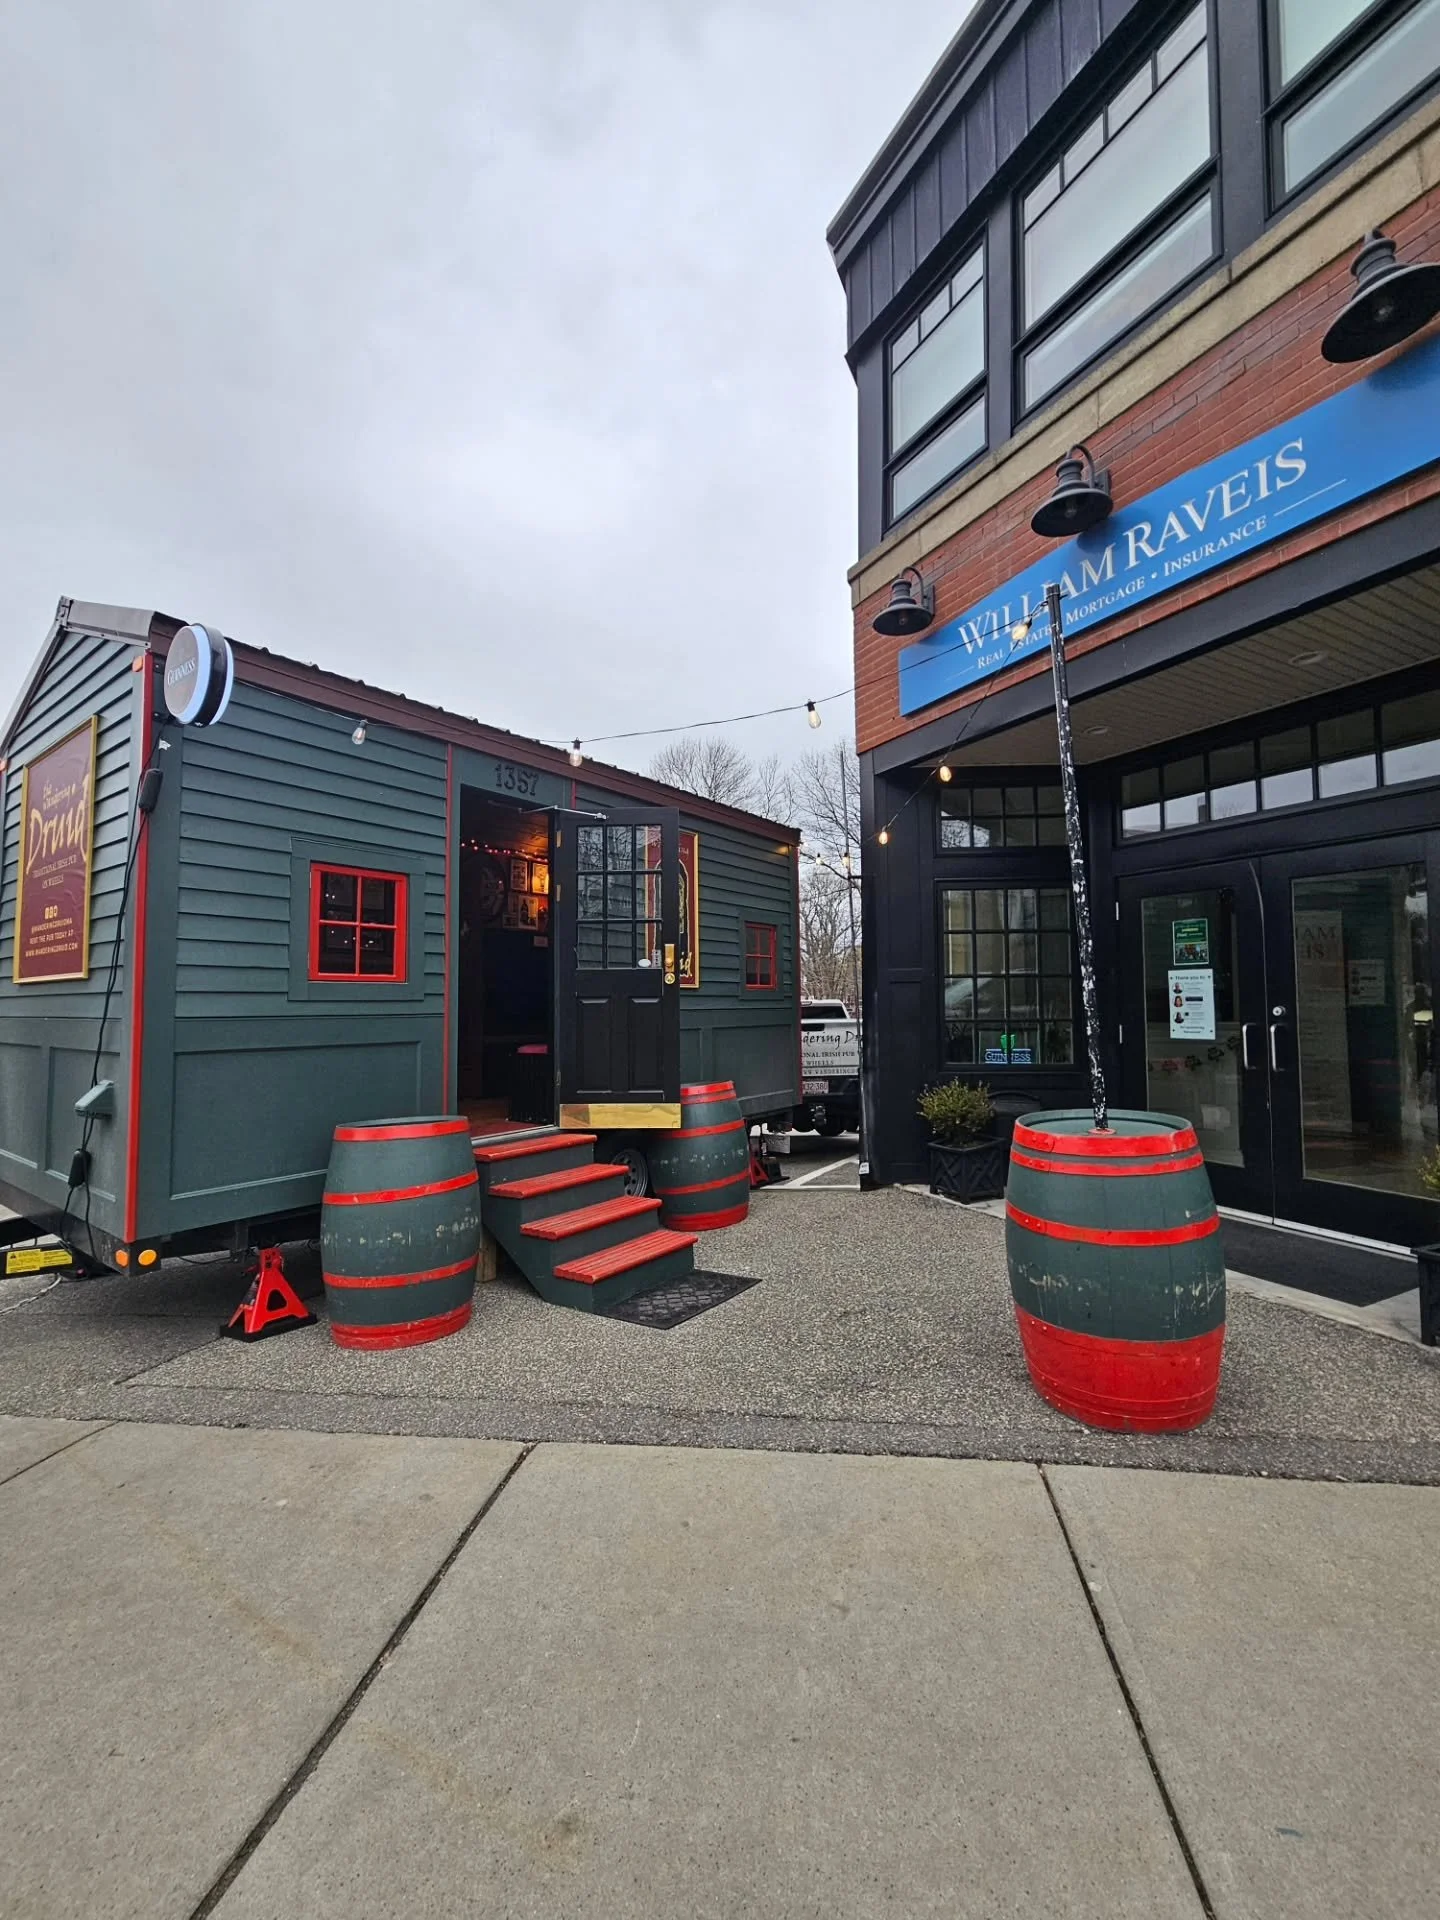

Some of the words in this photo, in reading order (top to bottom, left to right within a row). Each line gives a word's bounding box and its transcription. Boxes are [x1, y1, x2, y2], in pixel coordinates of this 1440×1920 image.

[958, 542, 1117, 655] WILLIAM
[1122, 437, 1307, 572] RAVEIS
[977, 648, 1005, 669] REAL
[1065, 576, 1145, 626] MORTGAGE
[1164, 514, 1267, 577] INSURANCE
[494, 763, 540, 797] 1357
